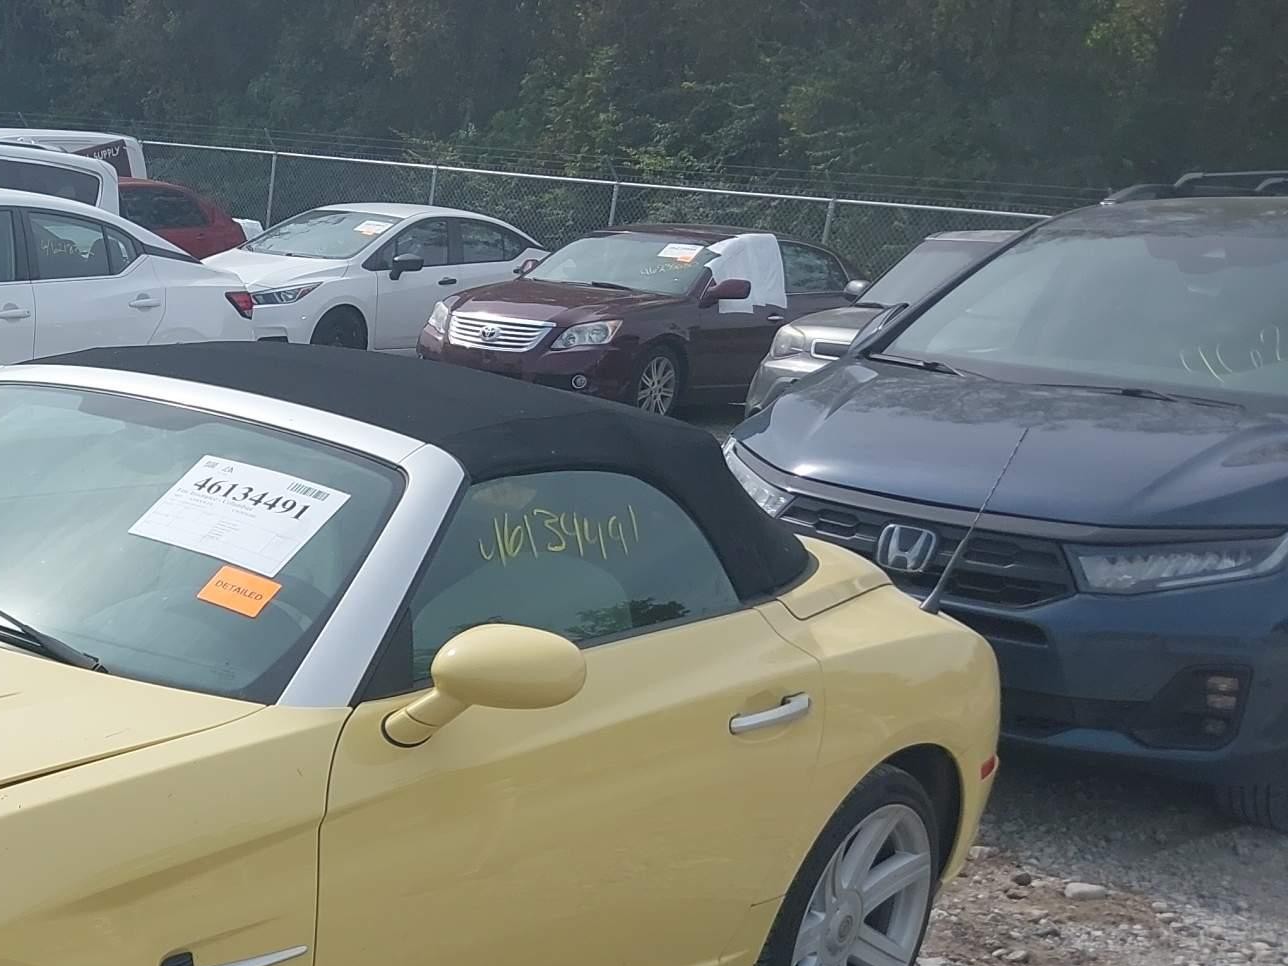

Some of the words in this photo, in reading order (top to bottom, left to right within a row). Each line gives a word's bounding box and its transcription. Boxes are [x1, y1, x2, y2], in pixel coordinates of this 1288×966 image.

[93, 145, 120, 160] SUPPLY
[193, 476, 312, 520] 46134491
[479, 504, 639, 567] 46134491
[215, 579, 263, 602] DETAILED
